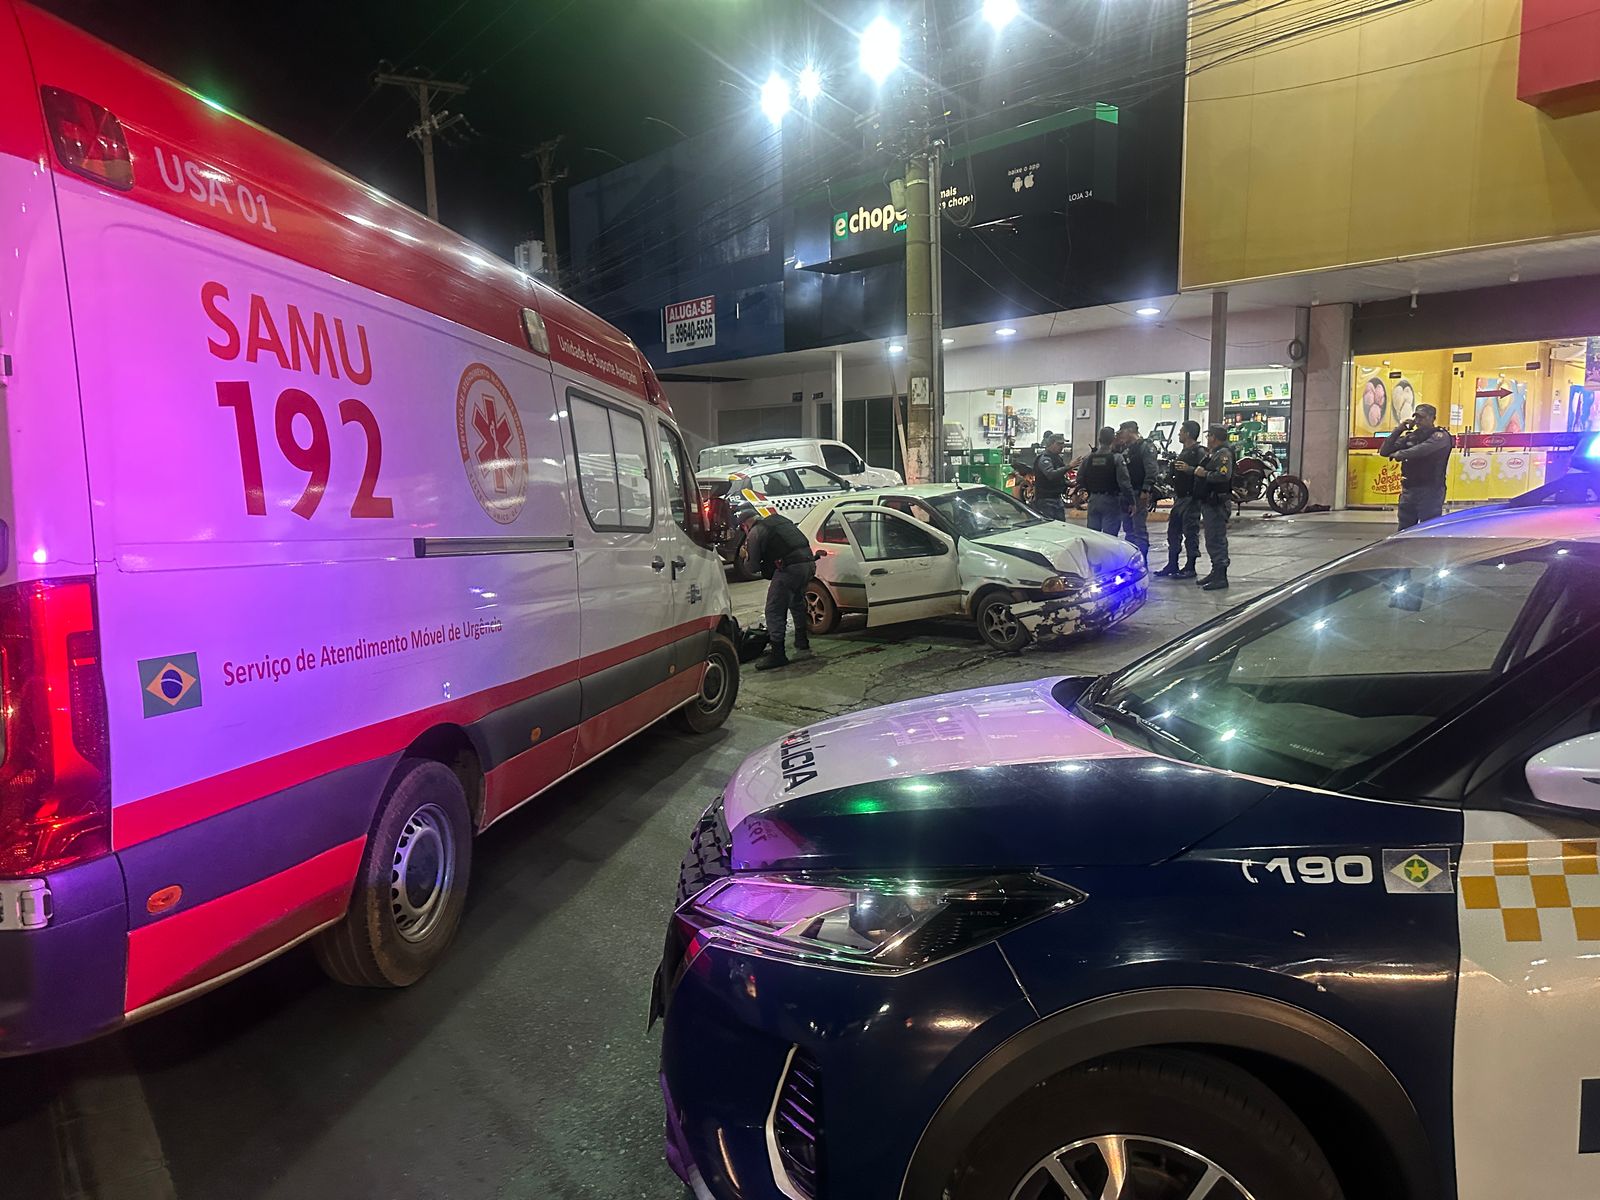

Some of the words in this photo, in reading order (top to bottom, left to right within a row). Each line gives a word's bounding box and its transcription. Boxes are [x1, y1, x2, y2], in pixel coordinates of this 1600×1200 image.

[154, 146, 233, 215] USA
[237, 184, 277, 233] 01
[1068, 193, 1084, 202] LOJA
[1084, 190, 1093, 198] 34
[200, 281, 373, 385] SAMU
[669, 299, 712, 322] ALUGA-SE
[557, 334, 587, 362] Unidade
[216, 381, 394, 520] 192
[223, 655, 291, 686] Serviço
[296, 648, 316, 672] de
[320, 635, 408, 667] Atendimento
[411, 626, 445, 650] Móvel
[448, 624, 461, 642] de
[463, 616, 503, 640] Urgência
[1265, 855, 1373, 884] 190
